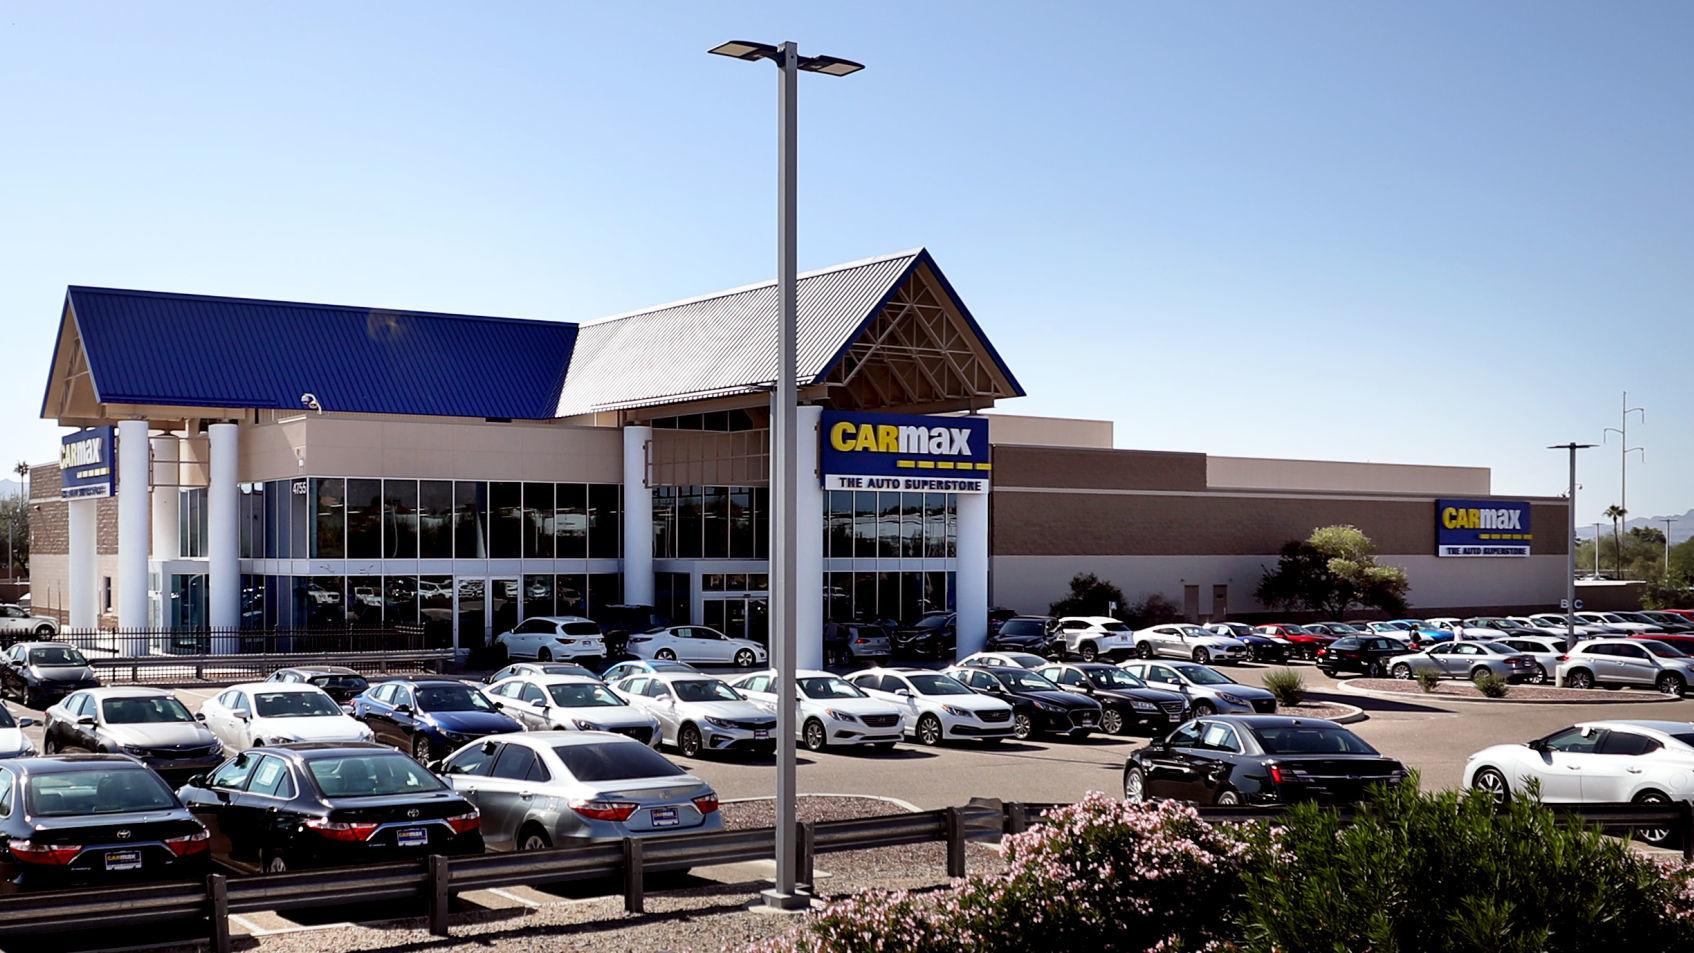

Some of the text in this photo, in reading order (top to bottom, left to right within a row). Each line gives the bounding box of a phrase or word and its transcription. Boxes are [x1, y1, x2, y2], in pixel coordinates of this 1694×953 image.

[830, 421, 972, 456] CARmax
[839, 477, 981, 491] THE AUTO SUPERSTORE
[1442, 507, 1521, 529] CARmax
[1446, 547, 1526, 555] THE AUTO SUPERSTORE
[1560, 599, 1569, 609] B
[1574, 599, 1584, 609] C
